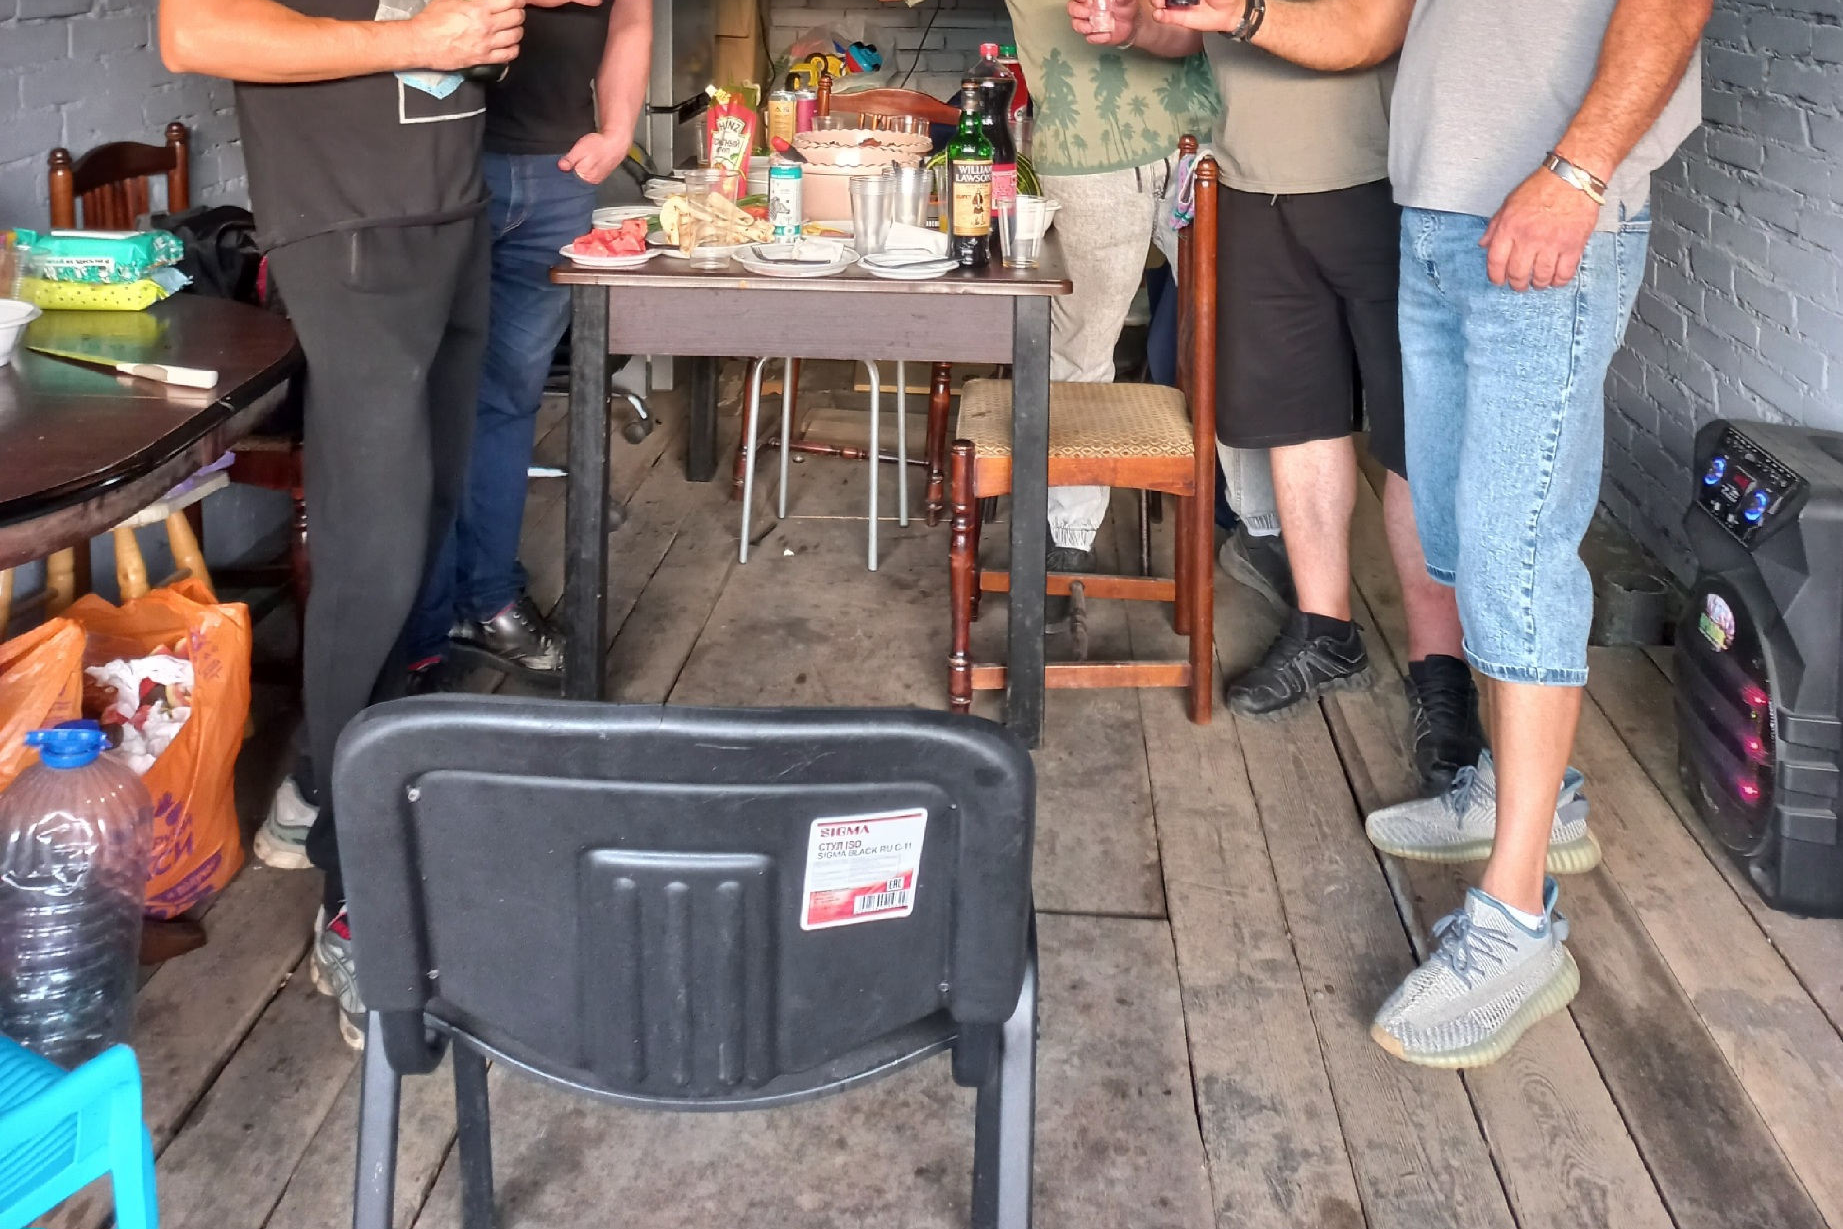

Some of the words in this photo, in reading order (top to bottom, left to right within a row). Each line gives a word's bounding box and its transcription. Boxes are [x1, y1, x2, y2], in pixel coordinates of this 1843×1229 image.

[820, 825, 869, 837] SIGMA
[817, 851, 847, 860] SIGMA
[848, 846, 878, 857] BLACK
